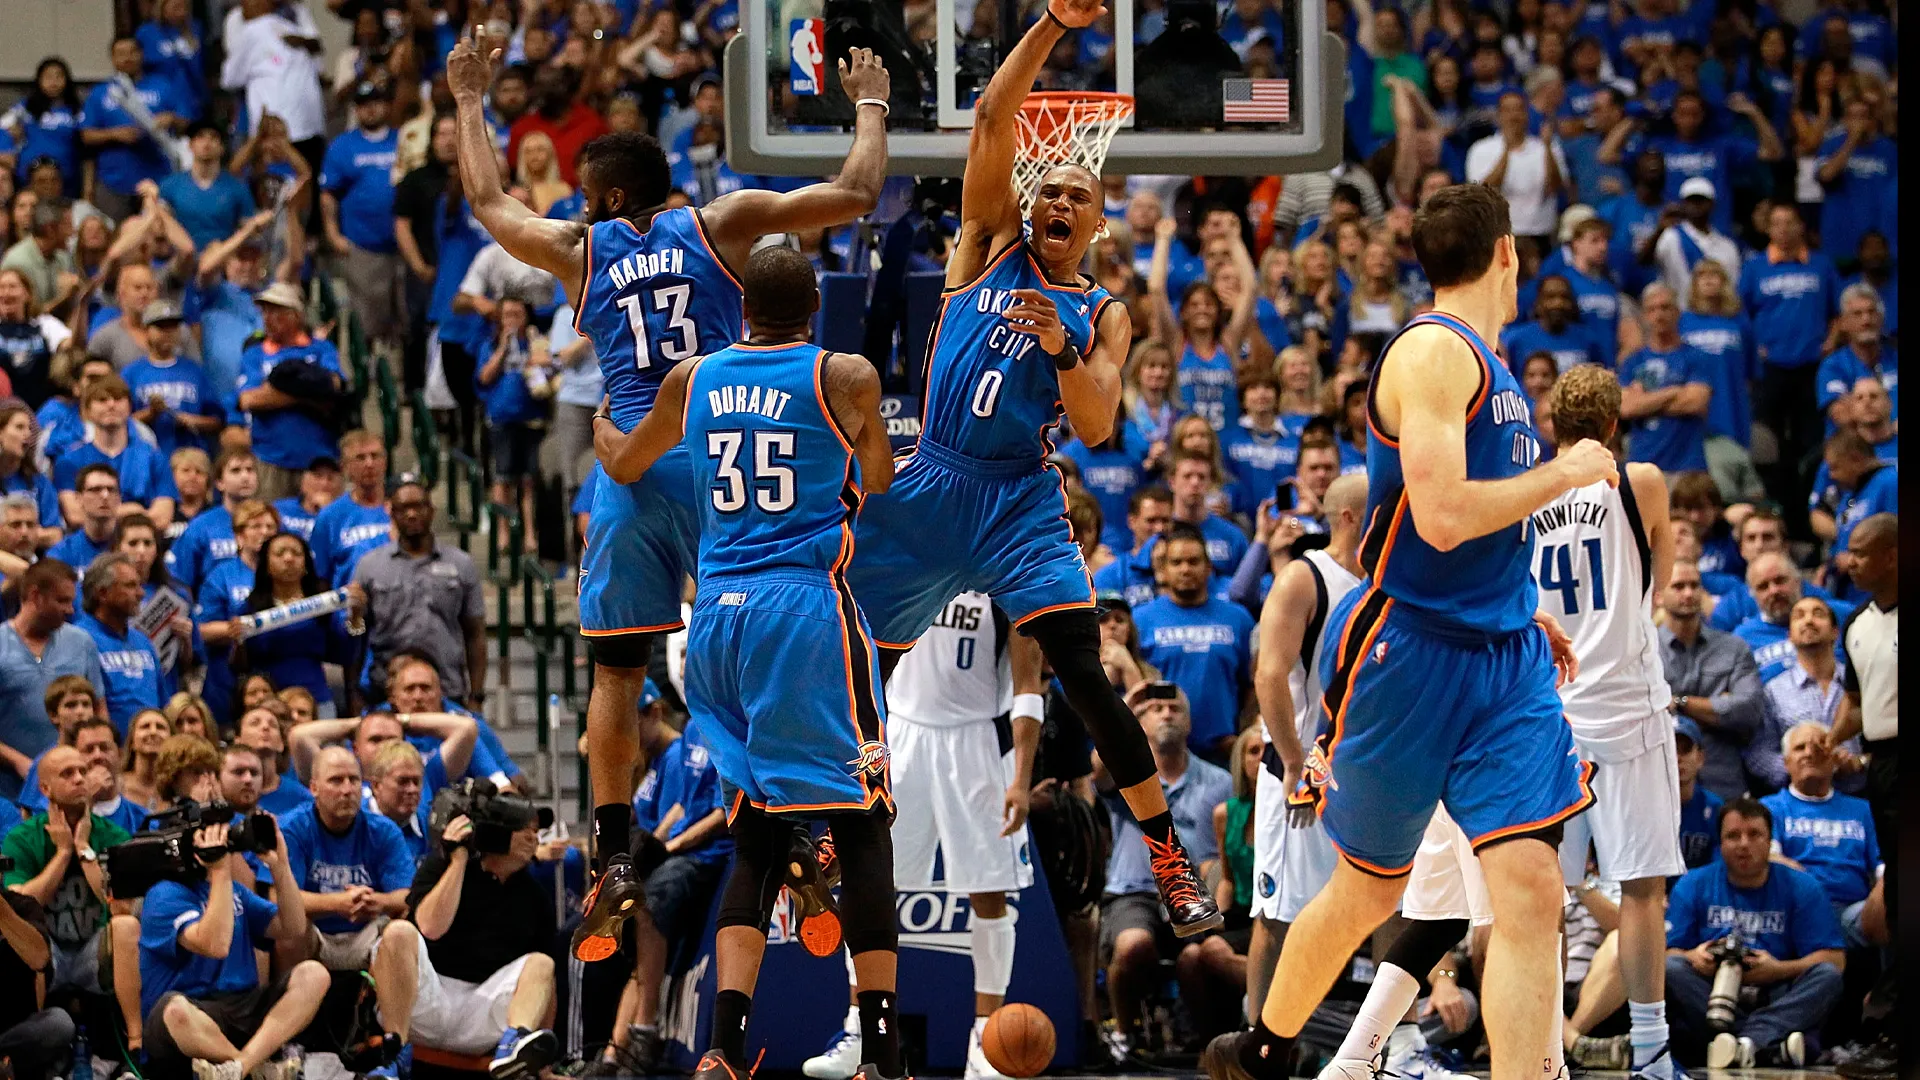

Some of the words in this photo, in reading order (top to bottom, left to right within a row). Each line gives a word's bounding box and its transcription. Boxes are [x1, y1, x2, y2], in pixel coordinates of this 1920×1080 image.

[608, 248, 684, 290] HARDEN
[614, 281, 700, 371] 13
[988, 325, 1036, 361] CITY
[708, 385, 792, 420] DURANT
[971, 369, 1004, 419] 0
[706, 430, 797, 514] 35
[1533, 502, 1608, 536] NOWITZKI
[1540, 538, 1607, 615] 41
[957, 636, 976, 669] 0
